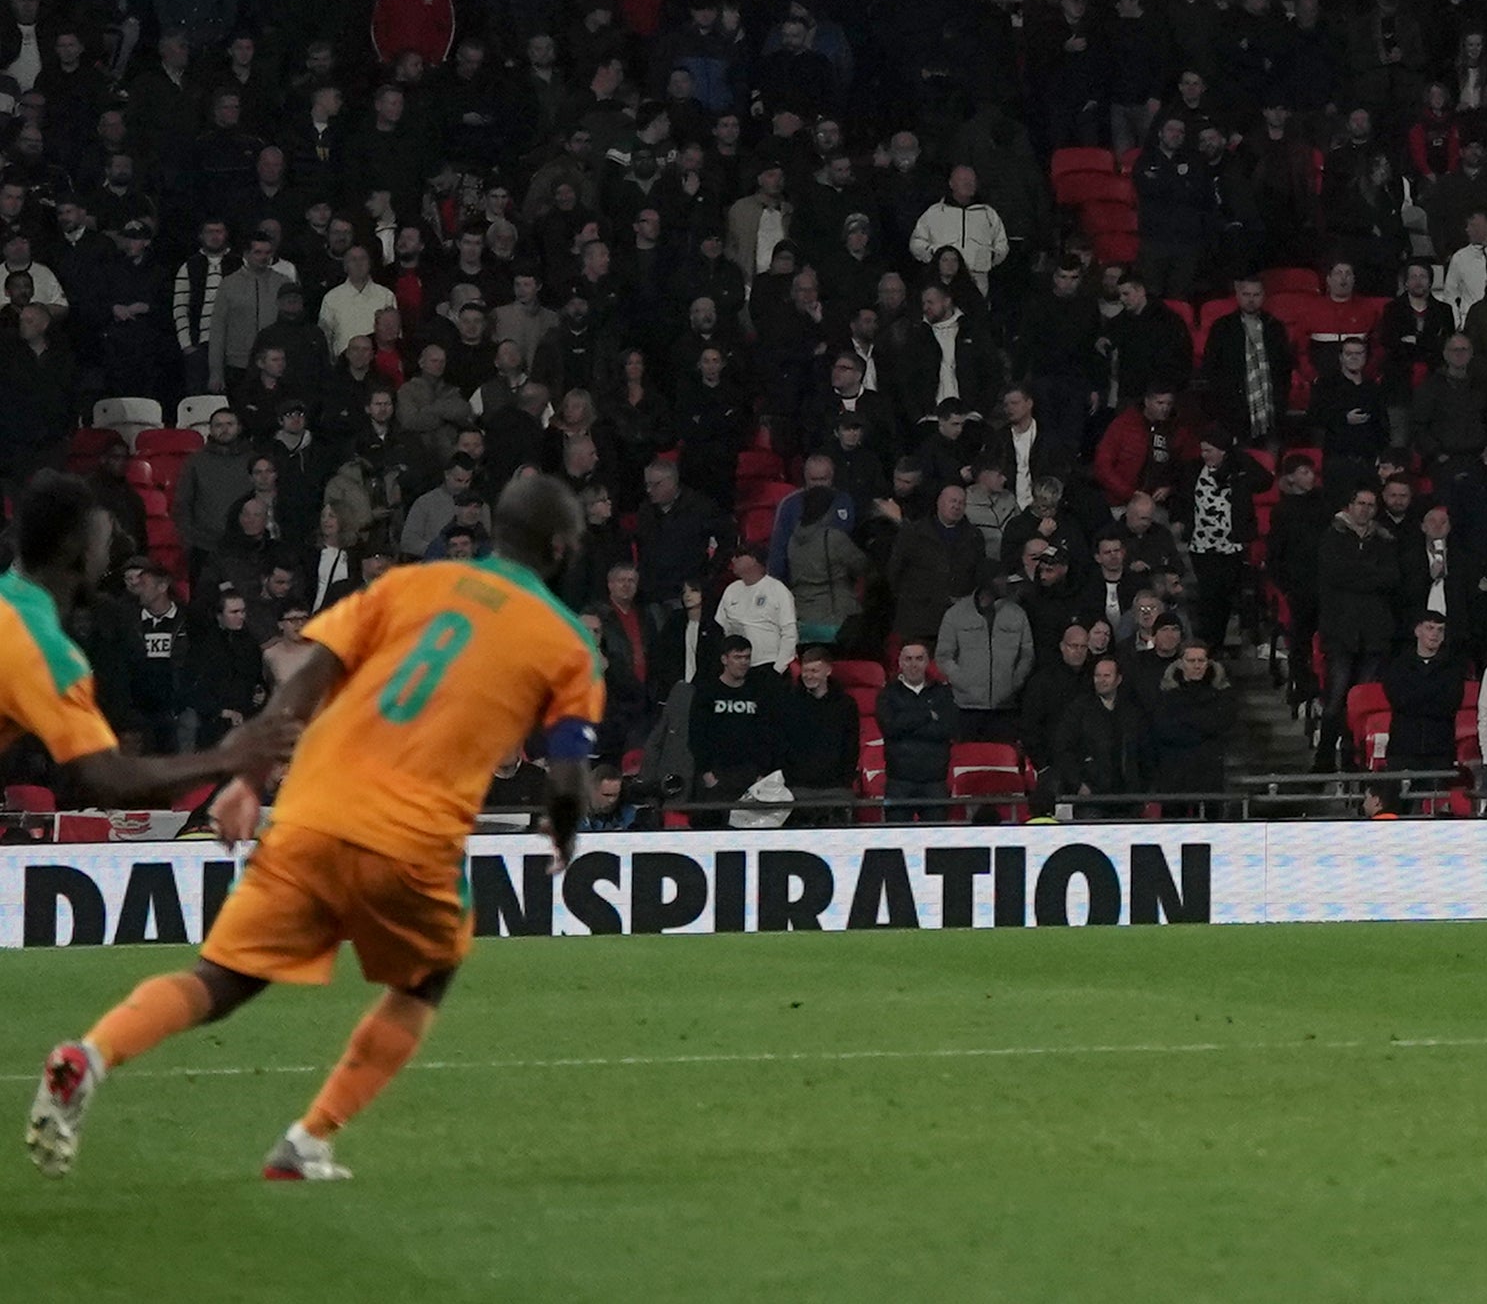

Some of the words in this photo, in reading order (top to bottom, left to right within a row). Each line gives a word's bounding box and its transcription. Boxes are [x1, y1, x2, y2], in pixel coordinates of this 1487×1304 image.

[377, 610, 473, 725] 8
[713, 699, 758, 715] DIOR
[24, 859, 236, 947] DAI
[470, 843, 1212, 937] NSPIRATION
